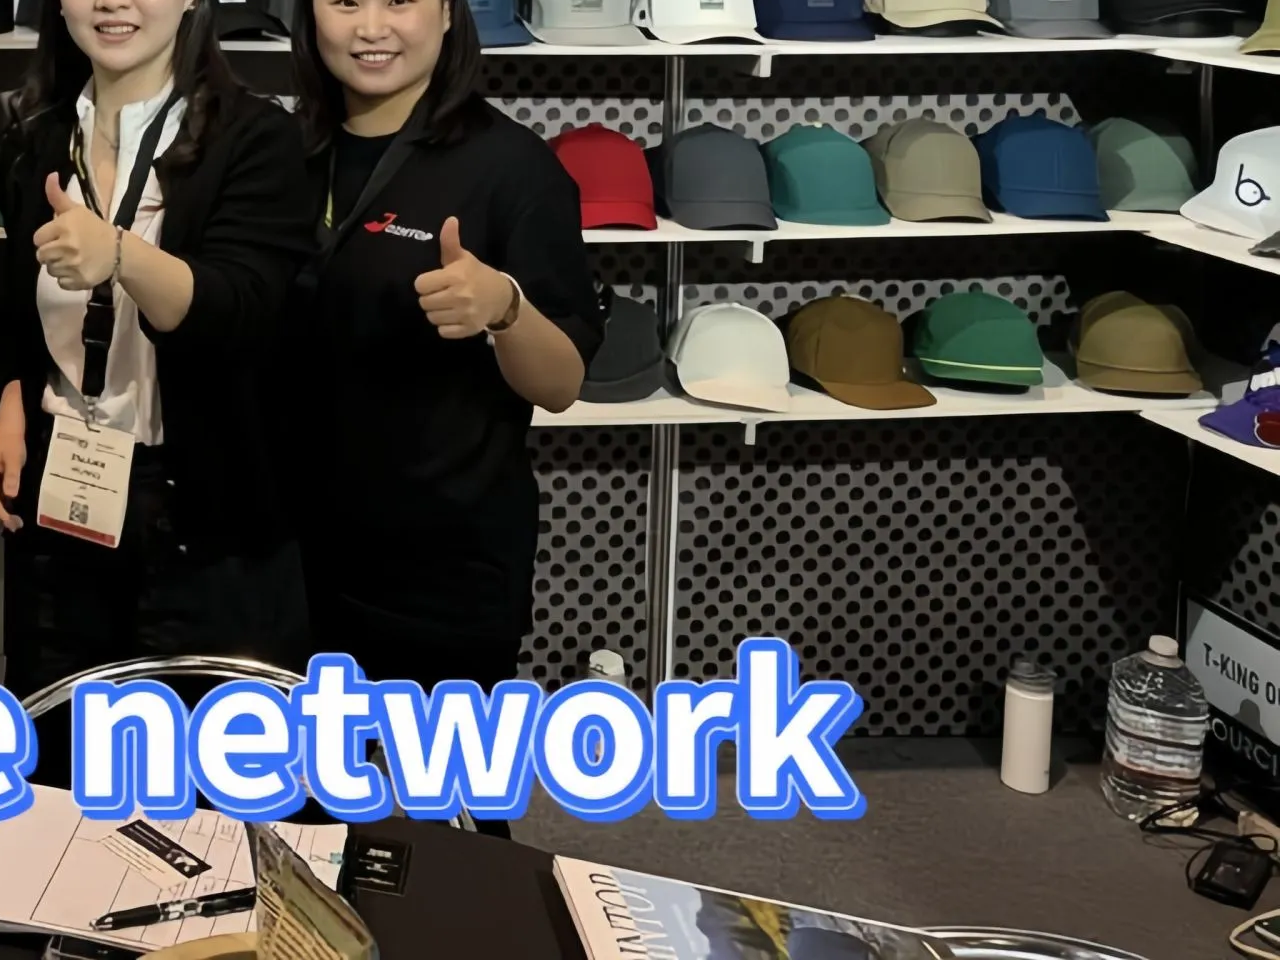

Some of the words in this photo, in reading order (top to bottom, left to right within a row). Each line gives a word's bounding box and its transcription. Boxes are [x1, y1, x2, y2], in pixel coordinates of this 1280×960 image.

[1203, 642, 1260, 695] T-KING
[1265, 681, 1280, 706] O
[1211, 717, 1278, 777] OURCI
